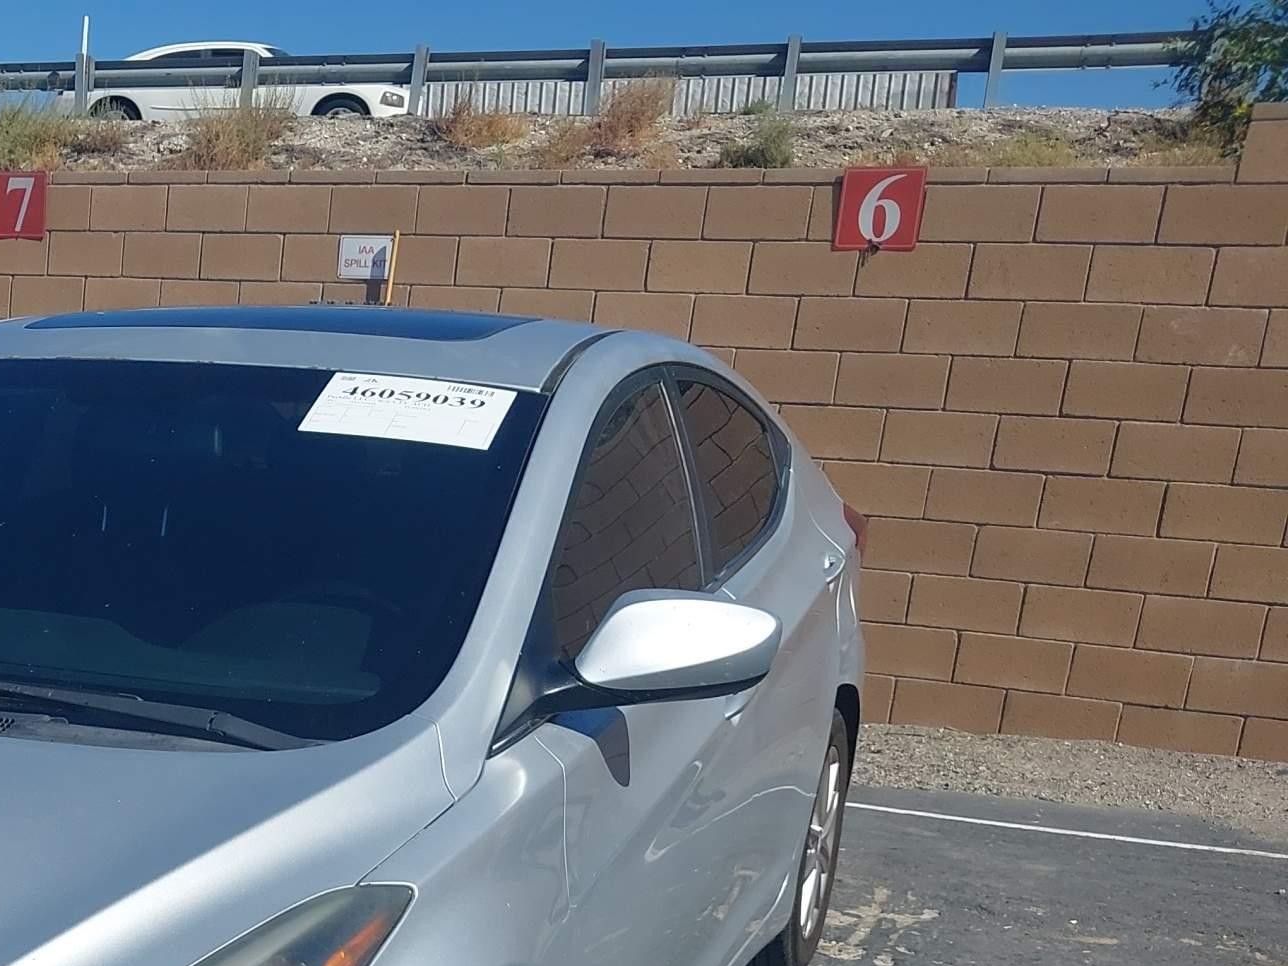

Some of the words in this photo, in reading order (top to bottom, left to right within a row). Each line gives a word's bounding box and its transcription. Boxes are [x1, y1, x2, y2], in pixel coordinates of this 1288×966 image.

[6, 177, 35, 232] 7
[858, 173, 908, 242] 6
[358, 245, 375, 255] IAA
[343, 258, 369, 268] SPILL
[372, 259, 387, 268] KIT
[341, 385, 486, 410] 46059039
